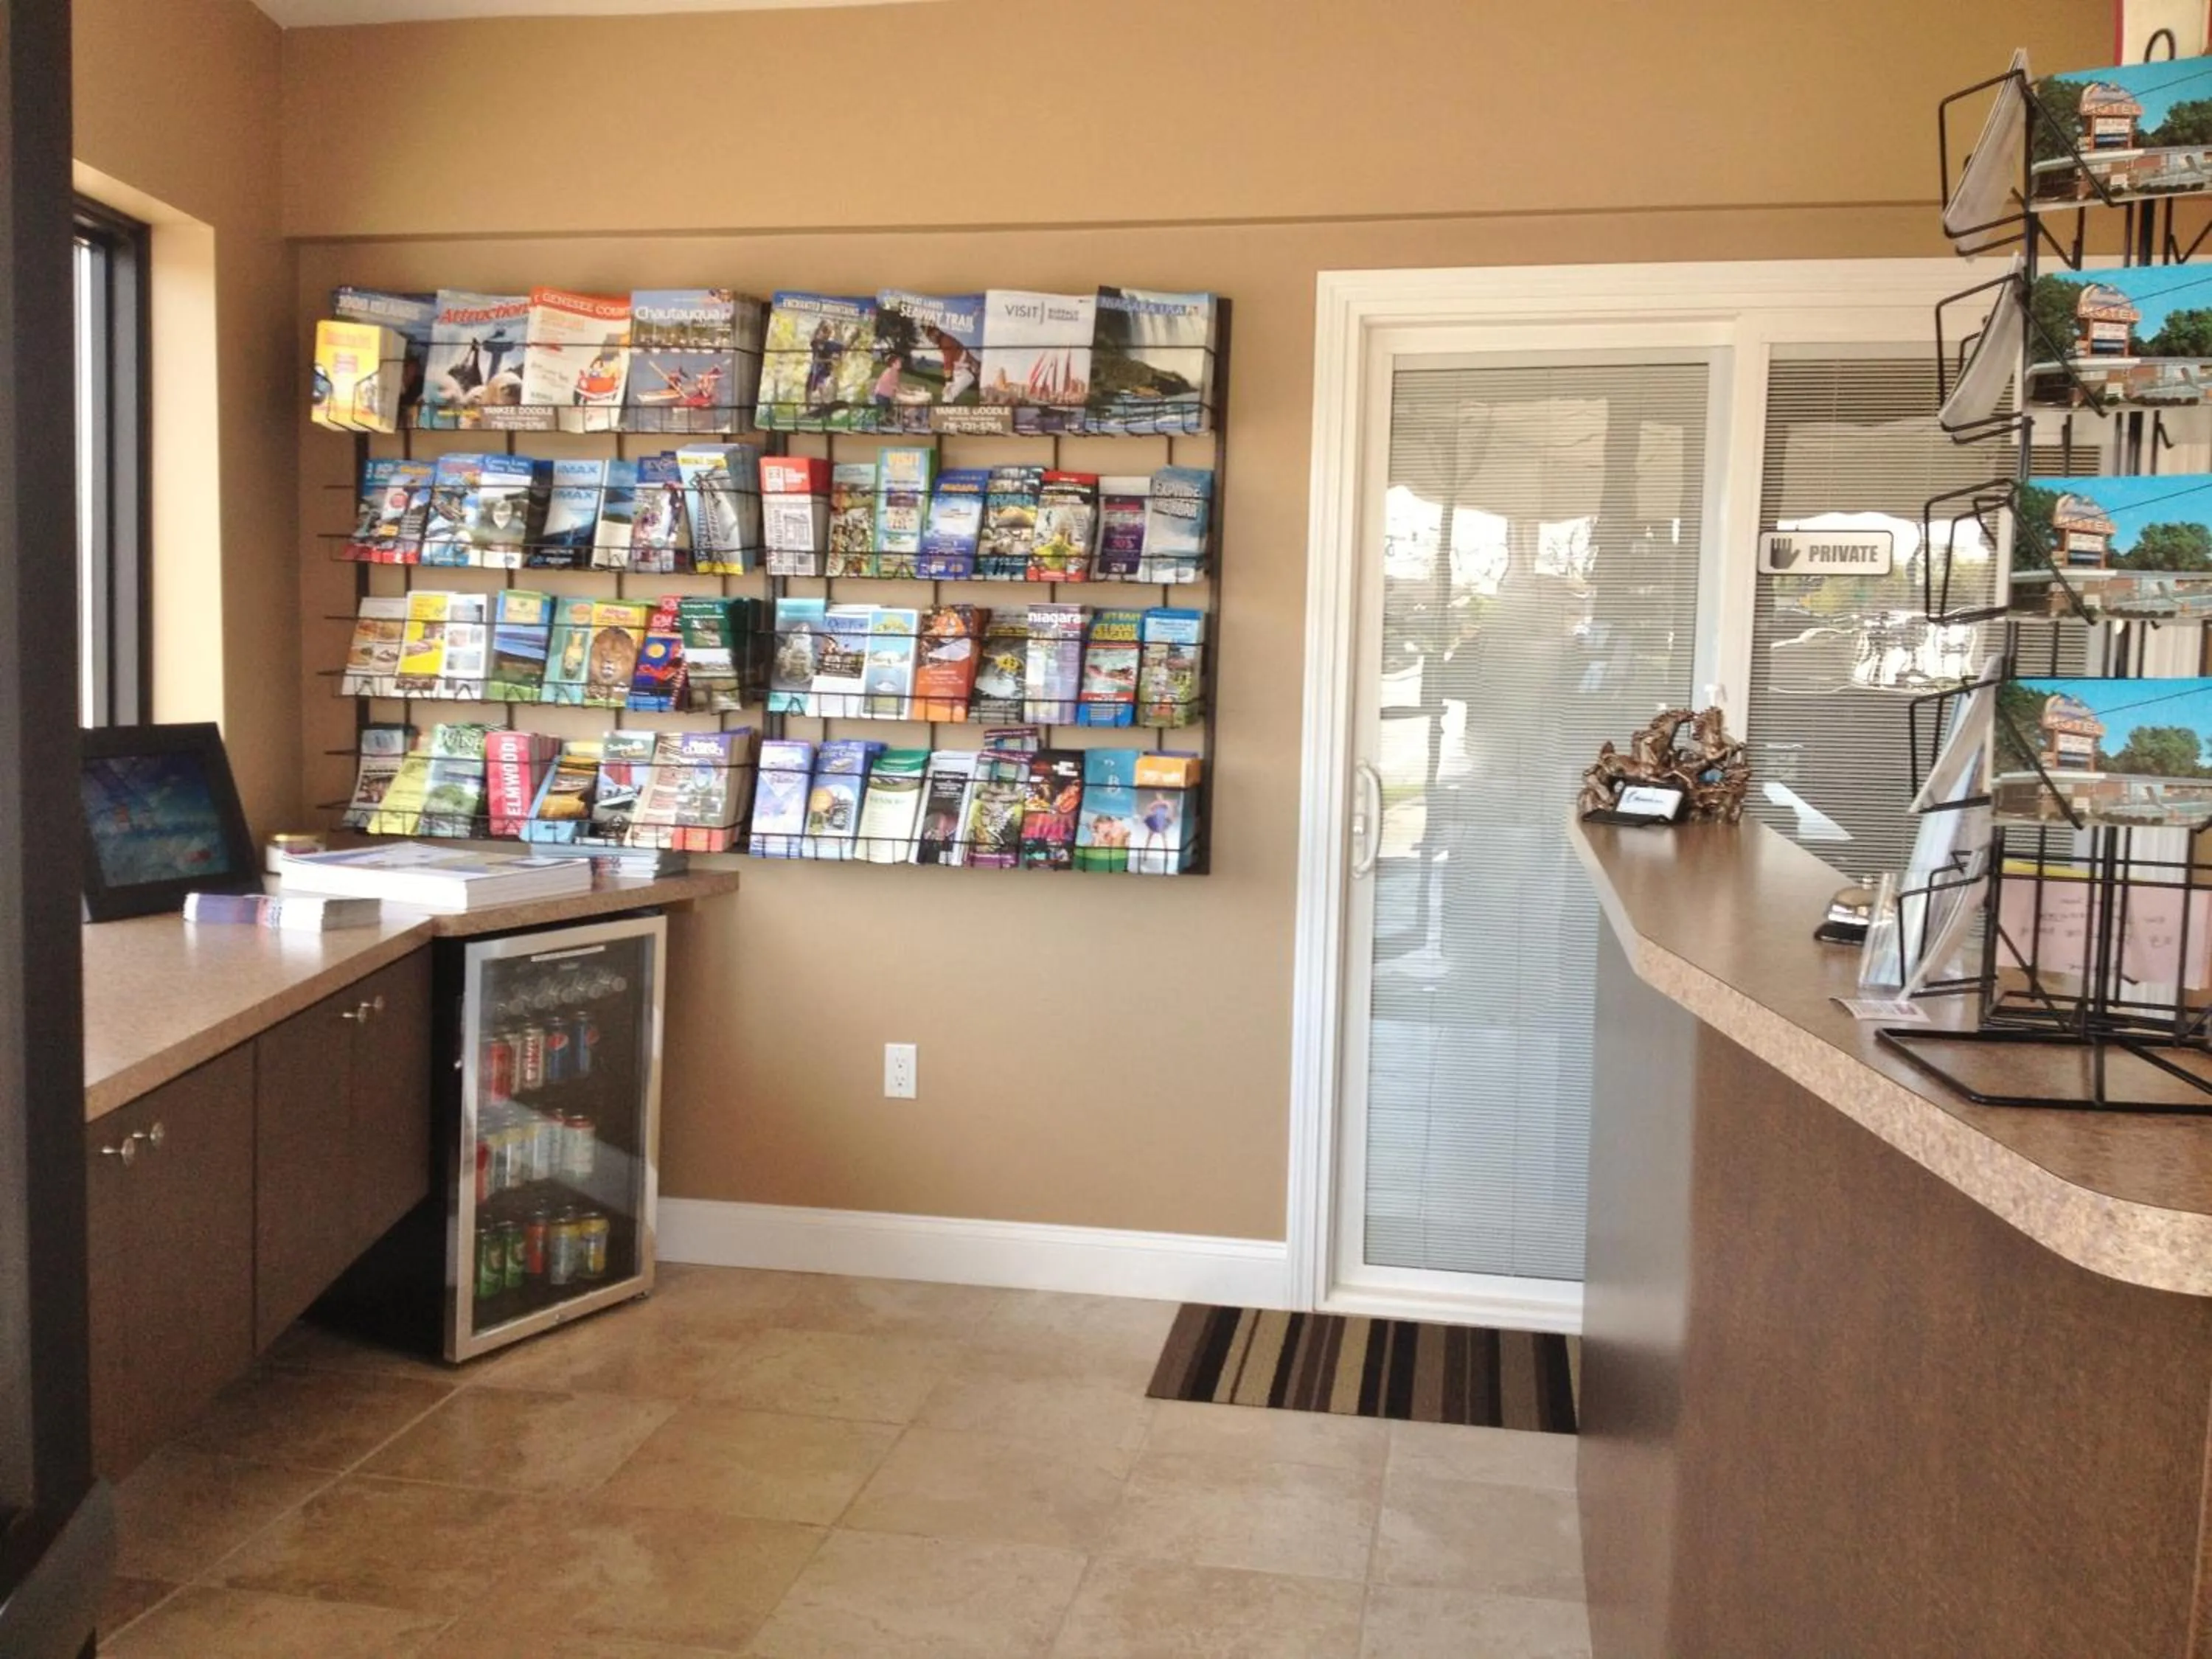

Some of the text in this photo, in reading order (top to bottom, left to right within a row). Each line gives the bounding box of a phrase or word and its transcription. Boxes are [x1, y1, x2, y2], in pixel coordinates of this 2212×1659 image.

[1005, 304, 1038, 319] VISIT
[1808, 545, 1879, 563] PRIVATE
[1028, 612, 1081, 629] niagara
[501, 741, 522, 815] ELMWOOD
